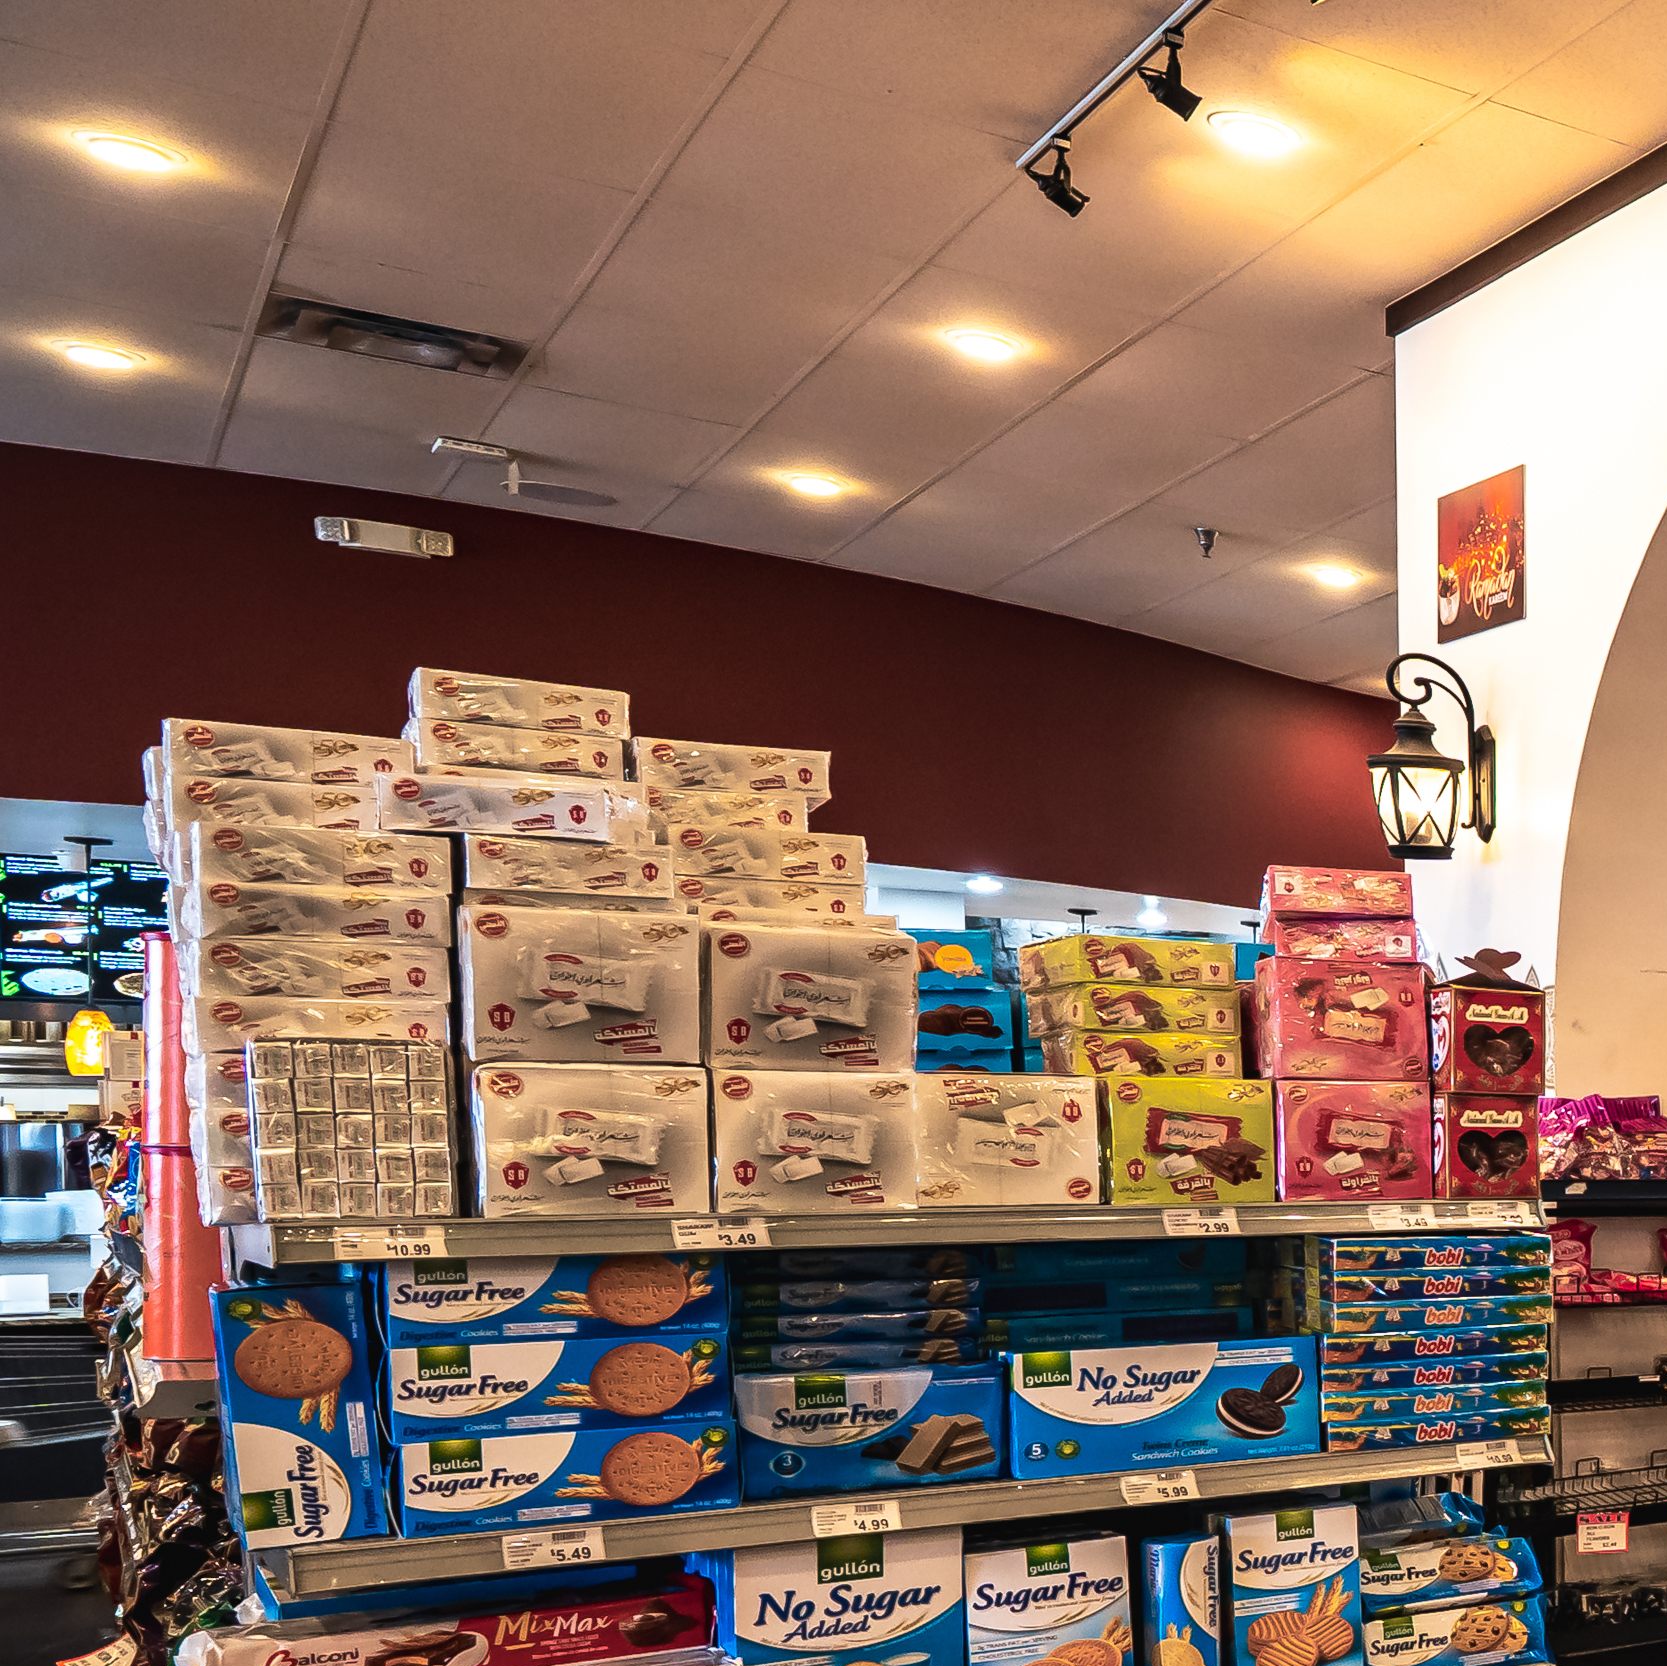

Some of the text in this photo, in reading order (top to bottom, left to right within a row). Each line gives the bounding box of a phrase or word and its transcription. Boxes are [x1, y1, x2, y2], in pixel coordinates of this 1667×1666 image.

[1199, 1222, 1230, 1234] $2.99
[718, 1231, 757, 1247] $3.49
[387, 1242, 431, 1258] $10.99
[1424, 1247, 1463, 1268] bobi
[417, 1267, 467, 1286] gullón
[1424, 1276, 1461, 1296] bobi
[1424, 1304, 1463, 1325] bobi
[1415, 1335, 1454, 1356] bobi
[419, 1360, 468, 1380] gullón
[1026, 1369, 1070, 1387] gullón
[1077, 1363, 1201, 1394] No Sugar
[1414, 1365, 1453, 1385] bobi
[797, 1391, 845, 1408] gullón
[1093, 1387, 1154, 1407] Added
[1414, 1393, 1454, 1414] bobi
[1416, 1421, 1455, 1442] bobi
[432, 1454, 482, 1474] gullón
[1156, 1484, 1190, 1498] $5.99
[853, 1518, 890, 1532] $4.99
[1278, 1527, 1312, 1541] gullón
[549, 1545, 592, 1562] $5.49
[820, 1560, 881, 1581] gullón
[1030, 1560, 1068, 1575] gullón
[753, 1583, 941, 1627] No Sugar
[494, 1611, 614, 1646] MixMax
[783, 1618, 871, 1643] Added
